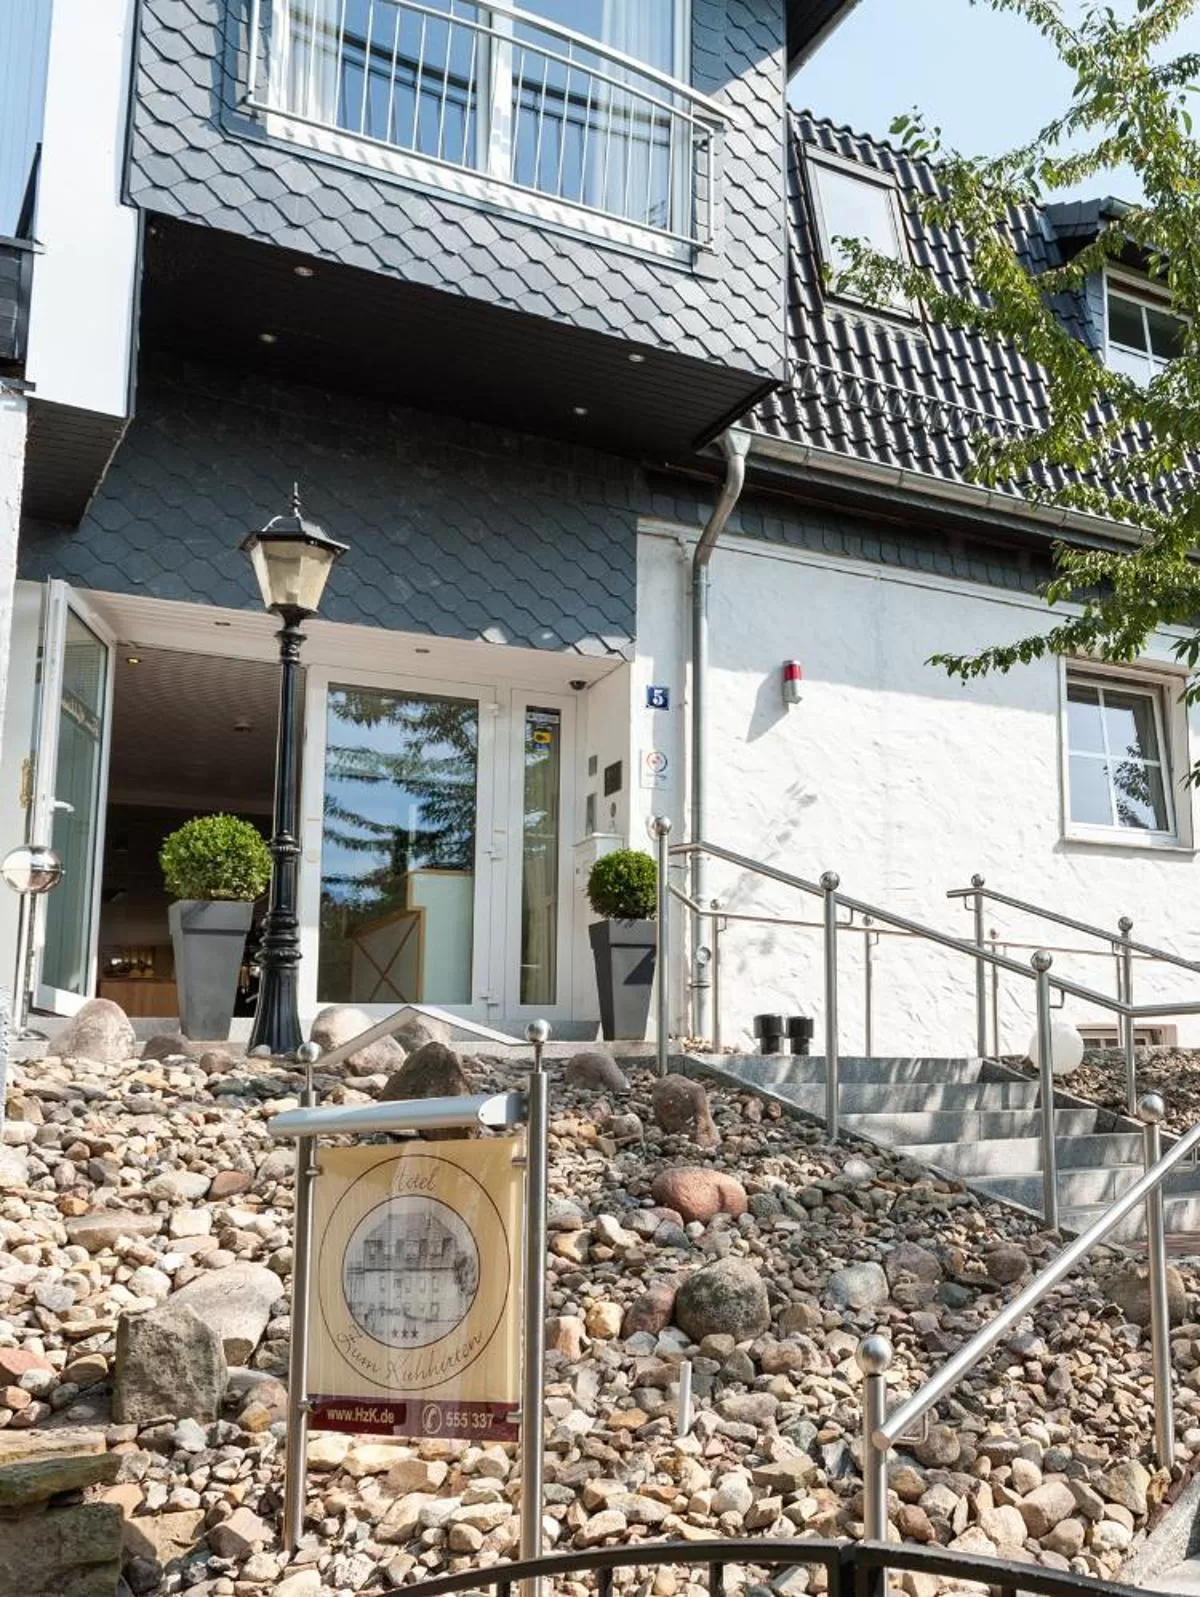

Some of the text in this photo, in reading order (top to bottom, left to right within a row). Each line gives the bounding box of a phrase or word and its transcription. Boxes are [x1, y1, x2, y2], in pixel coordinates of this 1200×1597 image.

[652, 688, 665, 706] 5
[326, 1406, 395, 1424] www.HzK.de
[446, 1411, 494, 1430] 555 337
